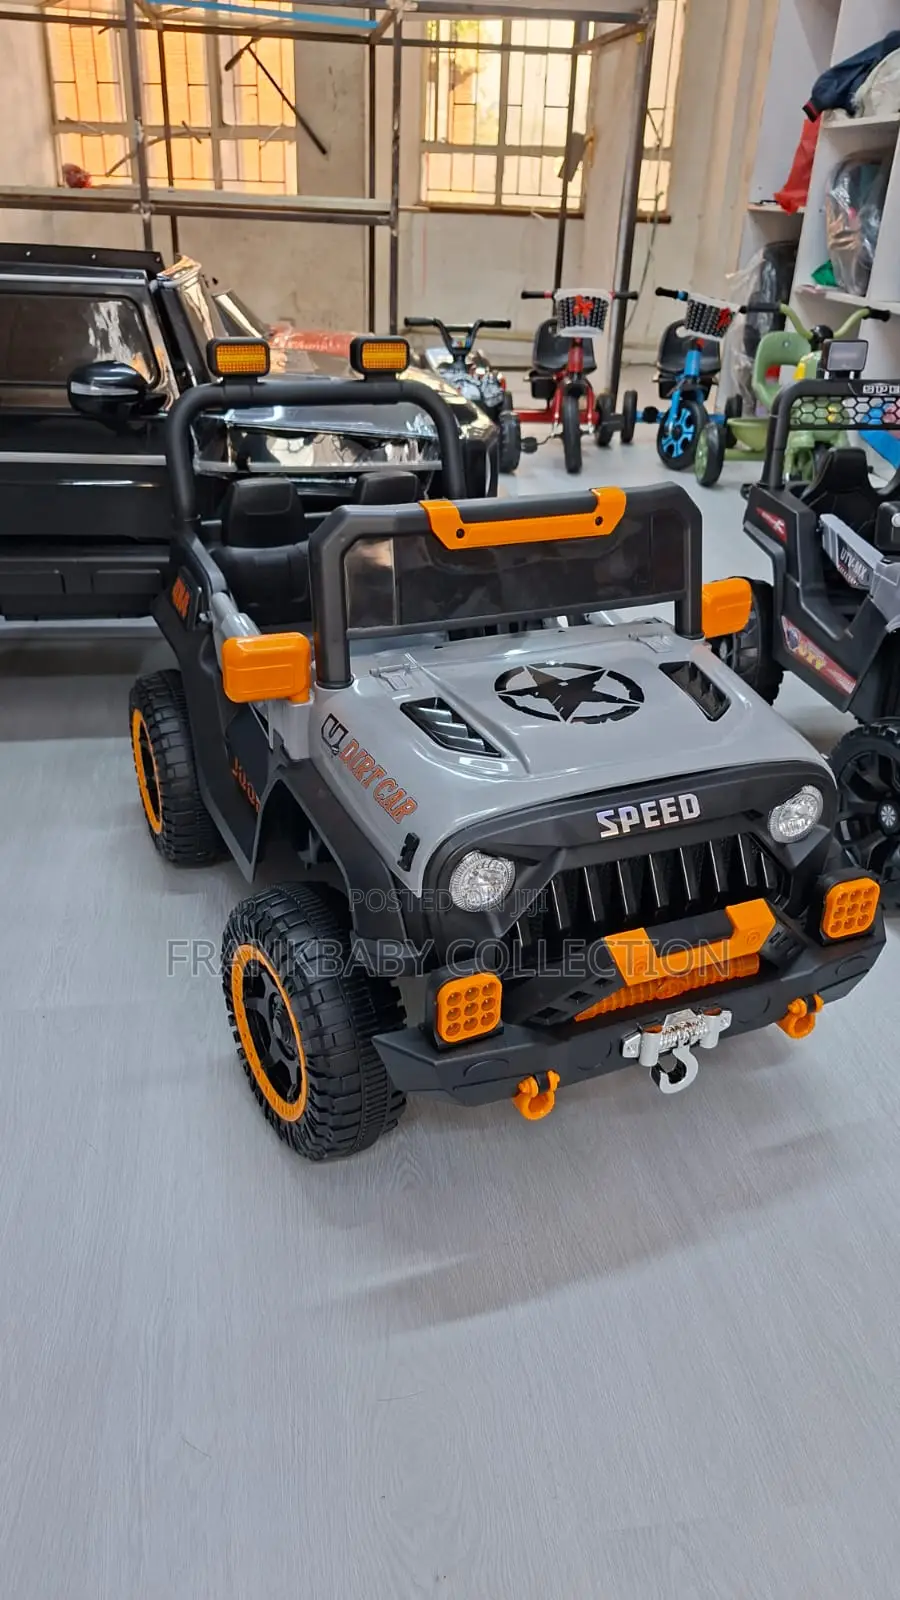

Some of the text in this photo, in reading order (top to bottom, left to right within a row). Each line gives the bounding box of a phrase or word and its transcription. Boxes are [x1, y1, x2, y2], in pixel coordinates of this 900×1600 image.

[338, 738, 419, 825] DIRT CAR
[595, 793, 702, 839] SPEED
